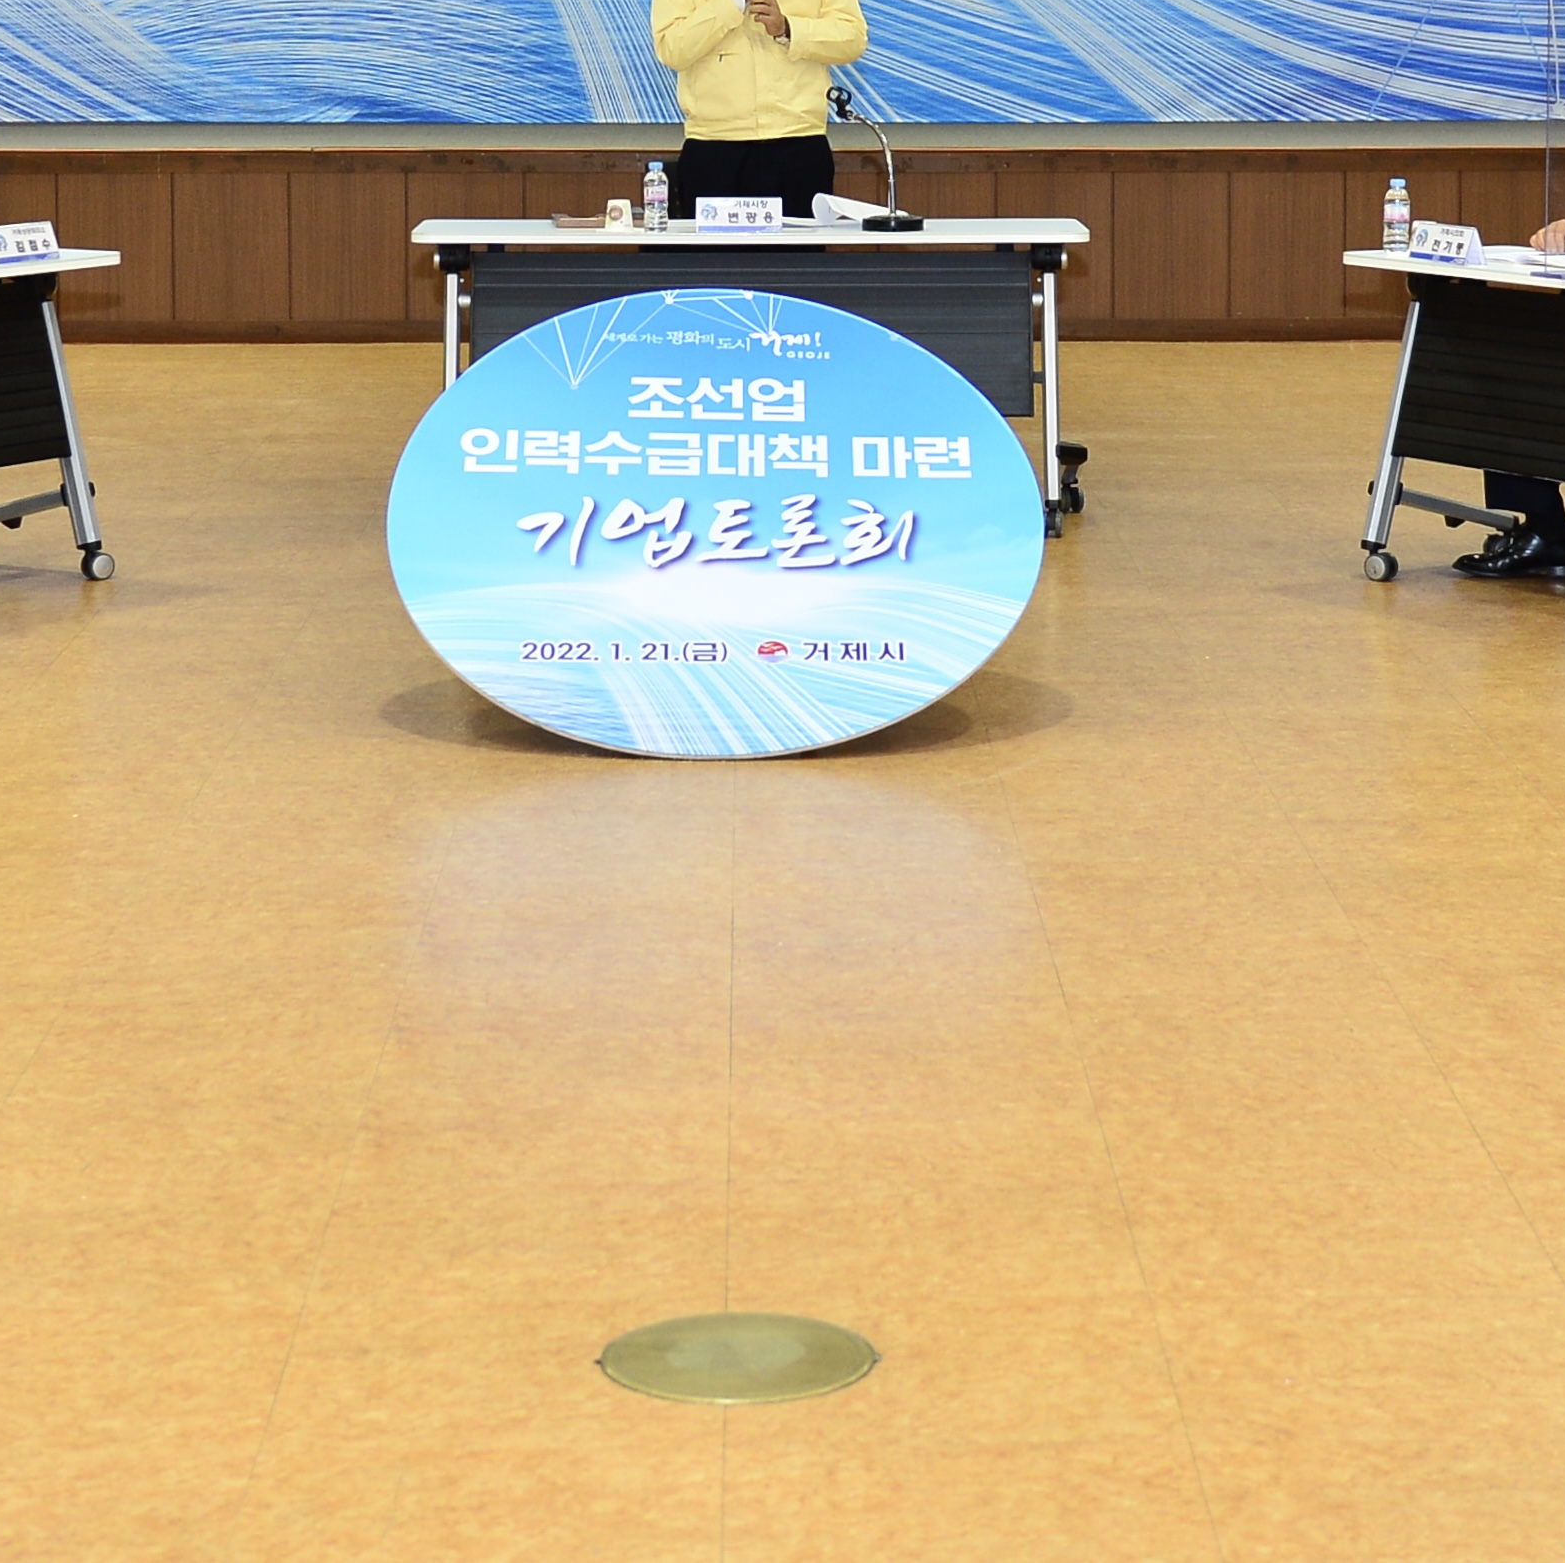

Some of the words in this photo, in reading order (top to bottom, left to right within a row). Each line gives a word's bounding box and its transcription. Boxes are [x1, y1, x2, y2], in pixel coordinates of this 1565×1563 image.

[734, 200, 768, 209] 거제시장
[639, 333, 664, 344] 가는
[666, 330, 715, 346] 평화의
[716, 336, 751, 352] 도시
[786, 350, 830, 360] GEOJE
[628, 377, 805, 422] 조선업
[460, 428, 828, 479] 인력수급대책
[852, 436, 972, 479] 마련
[516, 494, 914, 569] 기업토론회
[521, 642, 600, 661] 2022.
[610, 642, 631, 661] 1.
[641, 641, 728, 662] 21.(금)
[802, 641, 905, 662] 거제시
